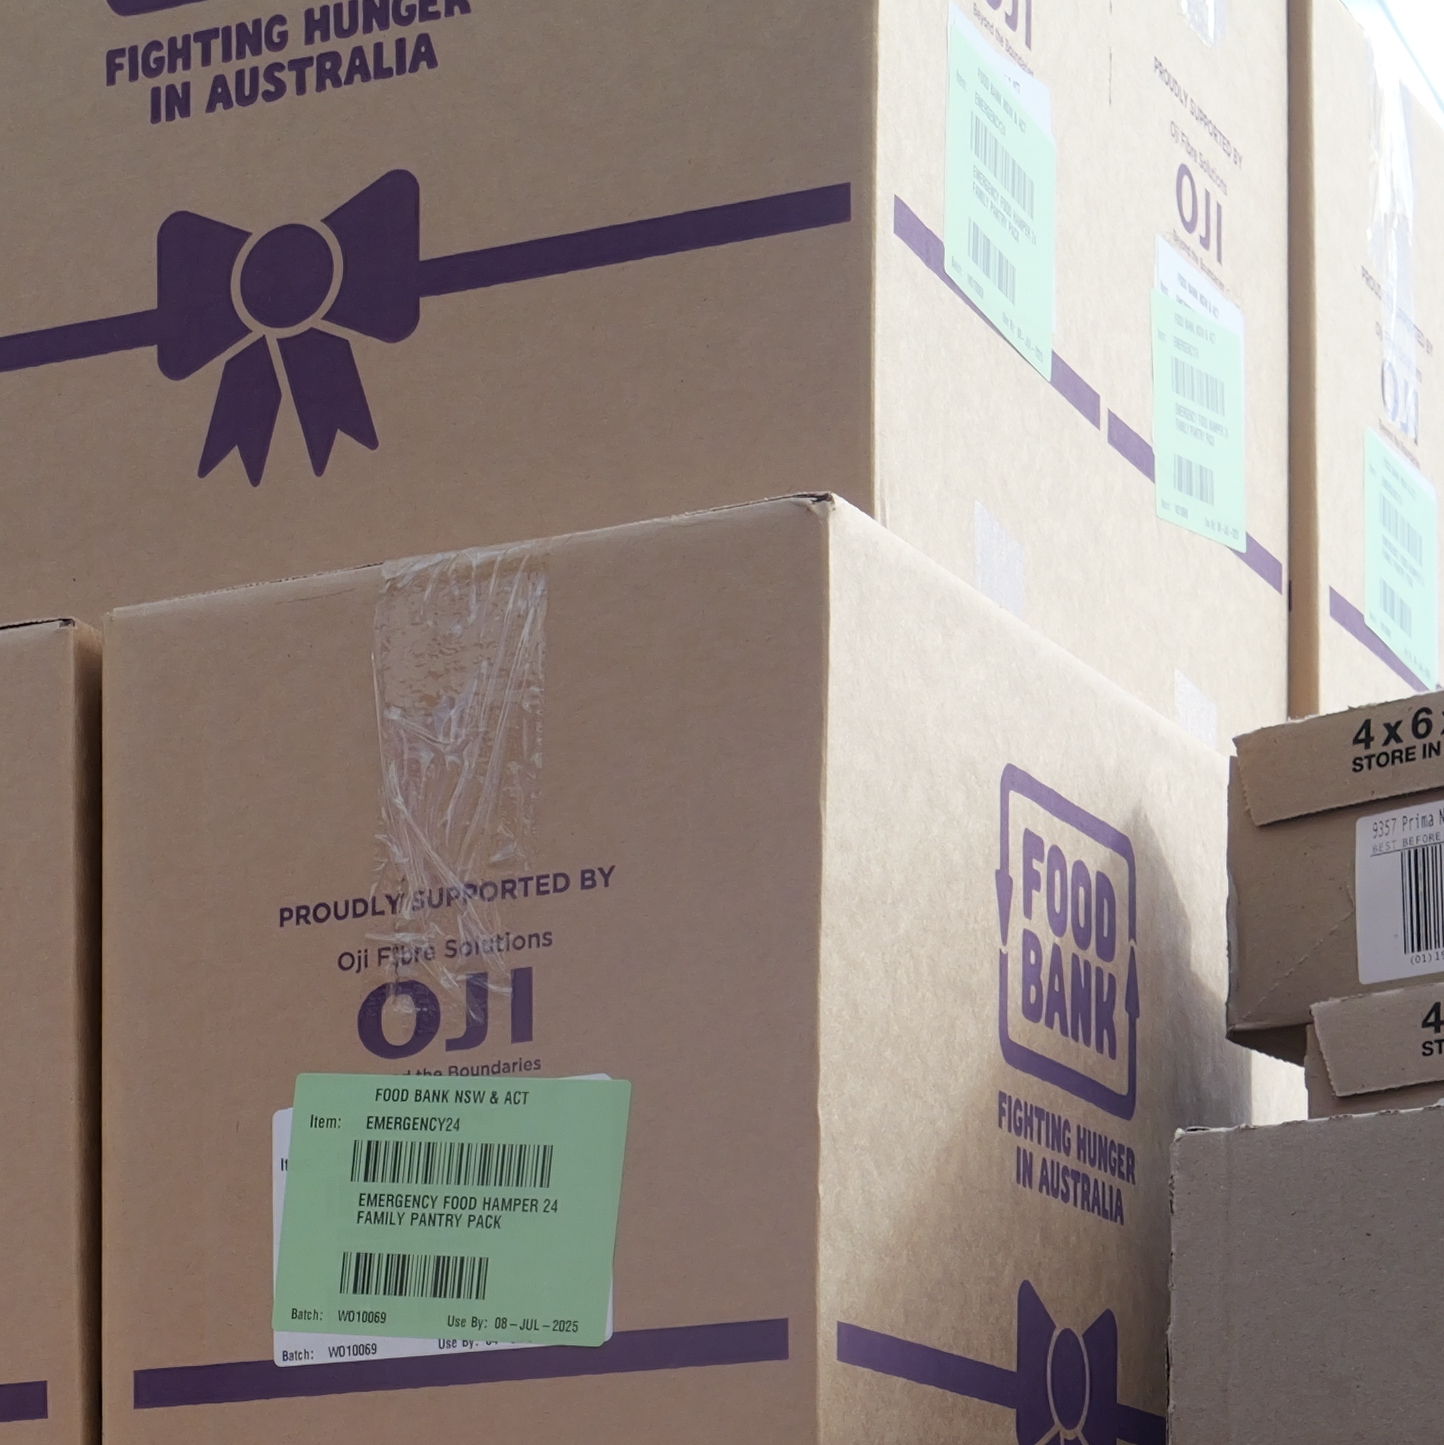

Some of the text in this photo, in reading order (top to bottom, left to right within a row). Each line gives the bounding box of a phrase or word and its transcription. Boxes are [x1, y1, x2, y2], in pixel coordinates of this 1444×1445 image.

[106, 14, 289, 87] FIGHTING
[150, 33, 439, 125] IN AUSTRALIA
[1176, 163, 1222, 266] OJI
[1352, 719, 1375, 750] 4
[1382, 719, 1403, 745] x
[1410, 707, 1433, 740] 6
[1352, 745, 1416, 773] STORE
[1422, 741, 1441, 758] IN
[1022, 827, 1116, 963] FOOD
[357, 967, 534, 1060] OJI
[1021, 928, 1117, 1061] BANK
[309, 1114, 461, 1133] Item: EMERGENCY24
[374, 1088, 529, 1105] FOOD BANK NSW & ACT
[997, 1090, 1136, 1187] FIGHTING HUNGER
[356, 1211, 502, 1230] FAMILY PANTRY PACK
[358, 1193, 558, 1213] EMERGENCY FOOD HAMPER 24
[1016, 1145, 1125, 1227] IN AUSTRALIA
[291, 1307, 488, 1331] Batch: Use By:
